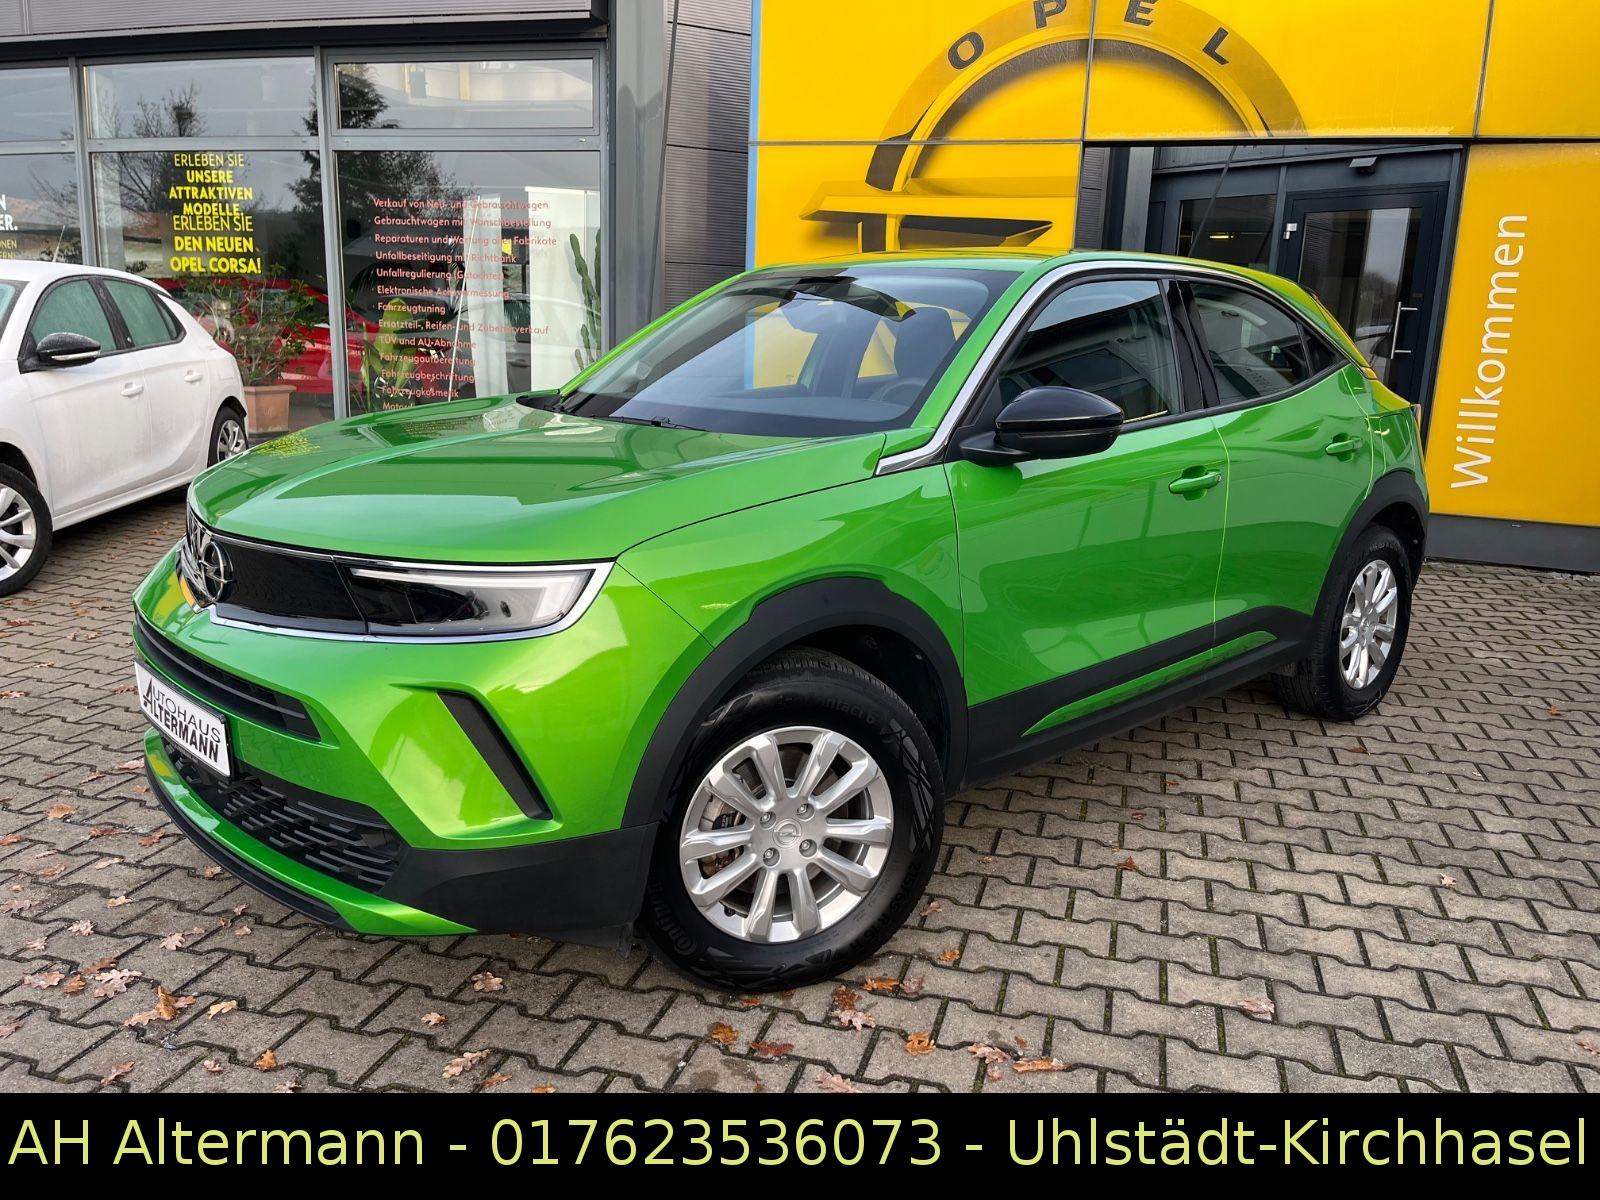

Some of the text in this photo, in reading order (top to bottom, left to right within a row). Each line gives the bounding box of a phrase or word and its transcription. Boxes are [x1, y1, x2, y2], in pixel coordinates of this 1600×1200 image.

[948, 0, 1230, 70] OPEL
[174, 153, 245, 167] ERLEBEN SIE
[186, 170, 234, 183] UNSERE
[169, 186, 253, 200] ATTRAKTIVEN
[183, 203, 244, 216] MODELLE.
[373, 198, 407, 208] Verkauf
[409, 200, 425, 208] von
[173, 215, 254, 232] ERLEBEN SIE
[374, 216, 450, 228] Gebrauchtwagen
[174, 236, 254, 253] DEN NEUEN
[375, 234, 430, 245] Reparaturen
[432, 235, 449, 244] und
[514, 236, 557, 246] Fabrikate
[375, 251, 452, 263] Unfallbeseitigung
[170, 256, 262, 274] OPEL CORSA!
[376, 268, 451, 280] Unfallregulierung
[377, 286, 433, 296] Elektronische
[377, 302, 446, 315] Fahrzeugtuning
[425, 321, 455, 330] Reifen-
[400, 337, 415, 346] und
[1450, 214, 1527, 488] Willkommen
